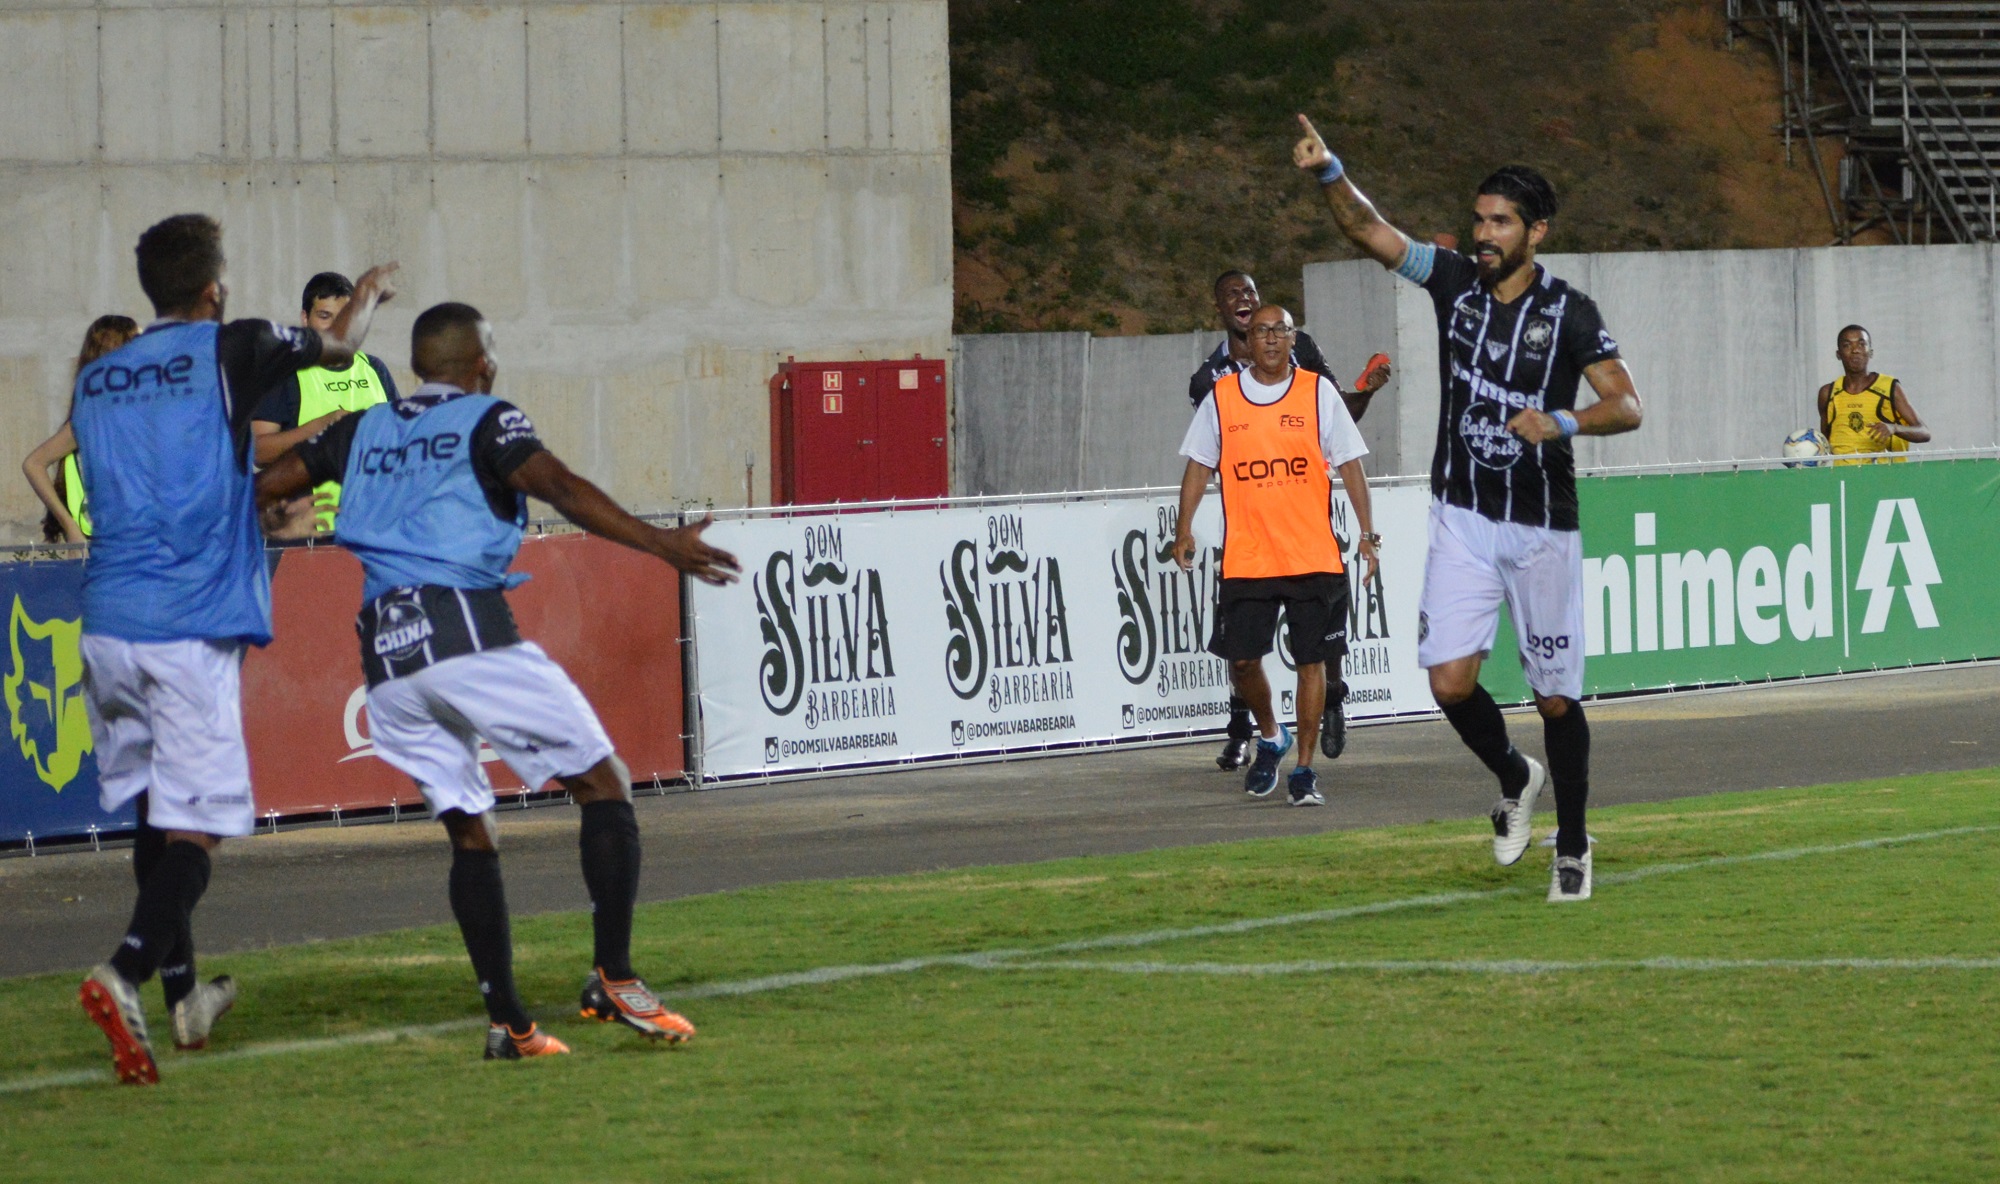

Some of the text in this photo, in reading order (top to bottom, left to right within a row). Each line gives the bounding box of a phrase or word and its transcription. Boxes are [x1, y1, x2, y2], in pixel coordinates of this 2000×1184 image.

[827, 374, 839, 388] H
[988, 513, 1024, 554] DOM
[1157, 505, 1179, 543] DO
[804, 524, 843, 565] DOM
[1582, 503, 1834, 656] nimed
[374, 617, 434, 655] CHINA
[753, 549, 896, 716] SILVA
[940, 538, 1073, 700] SILVA
[1157, 658, 1229, 698] BARBEARI
[1341, 643, 1391, 678] BEARIA
[805, 682, 897, 729] BARBEARIA
[989, 666, 1074, 713] BARBEARIA
[966, 714, 1076, 740] @DOMSILVABARBEARIA
[1137, 701, 1231, 724] @DOMSILVABARBEAR
[781, 731, 898, 757] @DOMSILVABARBEARIA
